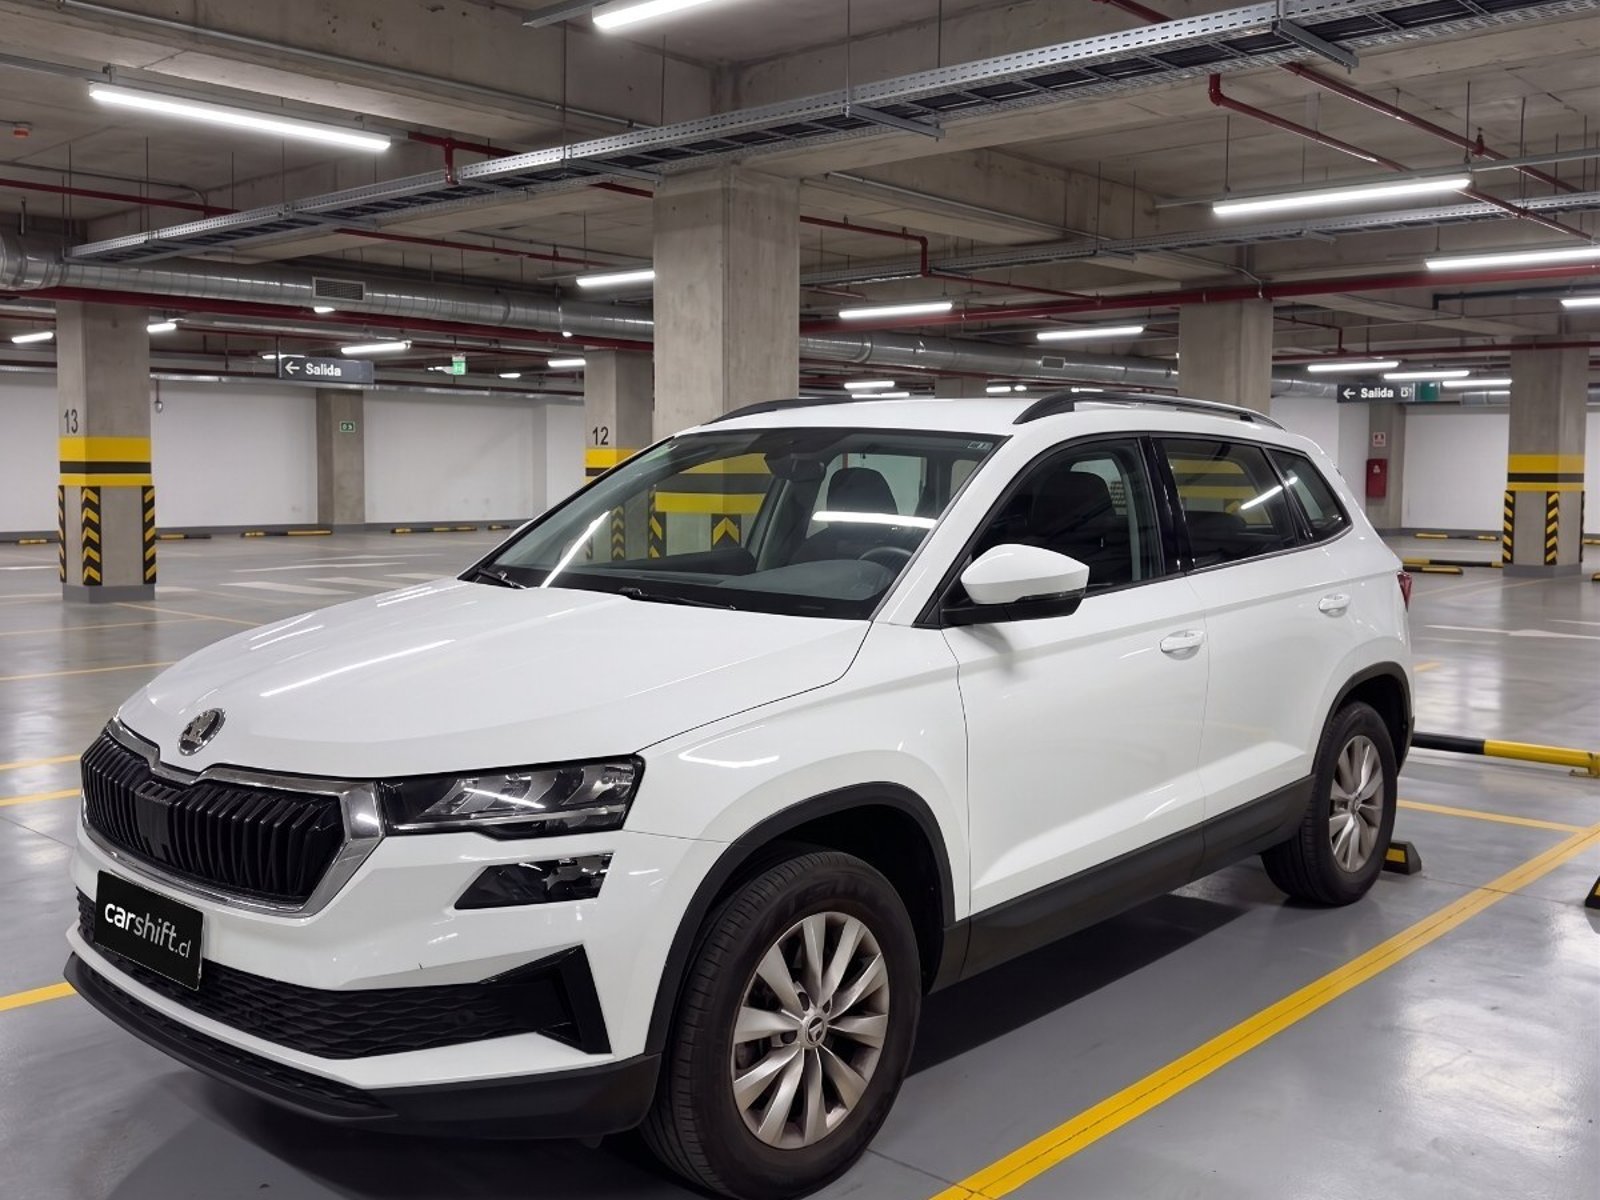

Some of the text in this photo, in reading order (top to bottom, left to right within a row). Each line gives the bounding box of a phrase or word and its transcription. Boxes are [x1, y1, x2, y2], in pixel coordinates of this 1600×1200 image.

[305, 362, 342, 376] Salida
[1360, 387, 1394, 398] Salida
[63, 408, 79, 434] 13
[592, 426, 609, 446] 12
[104, 903, 192, 958] carshift.cl
